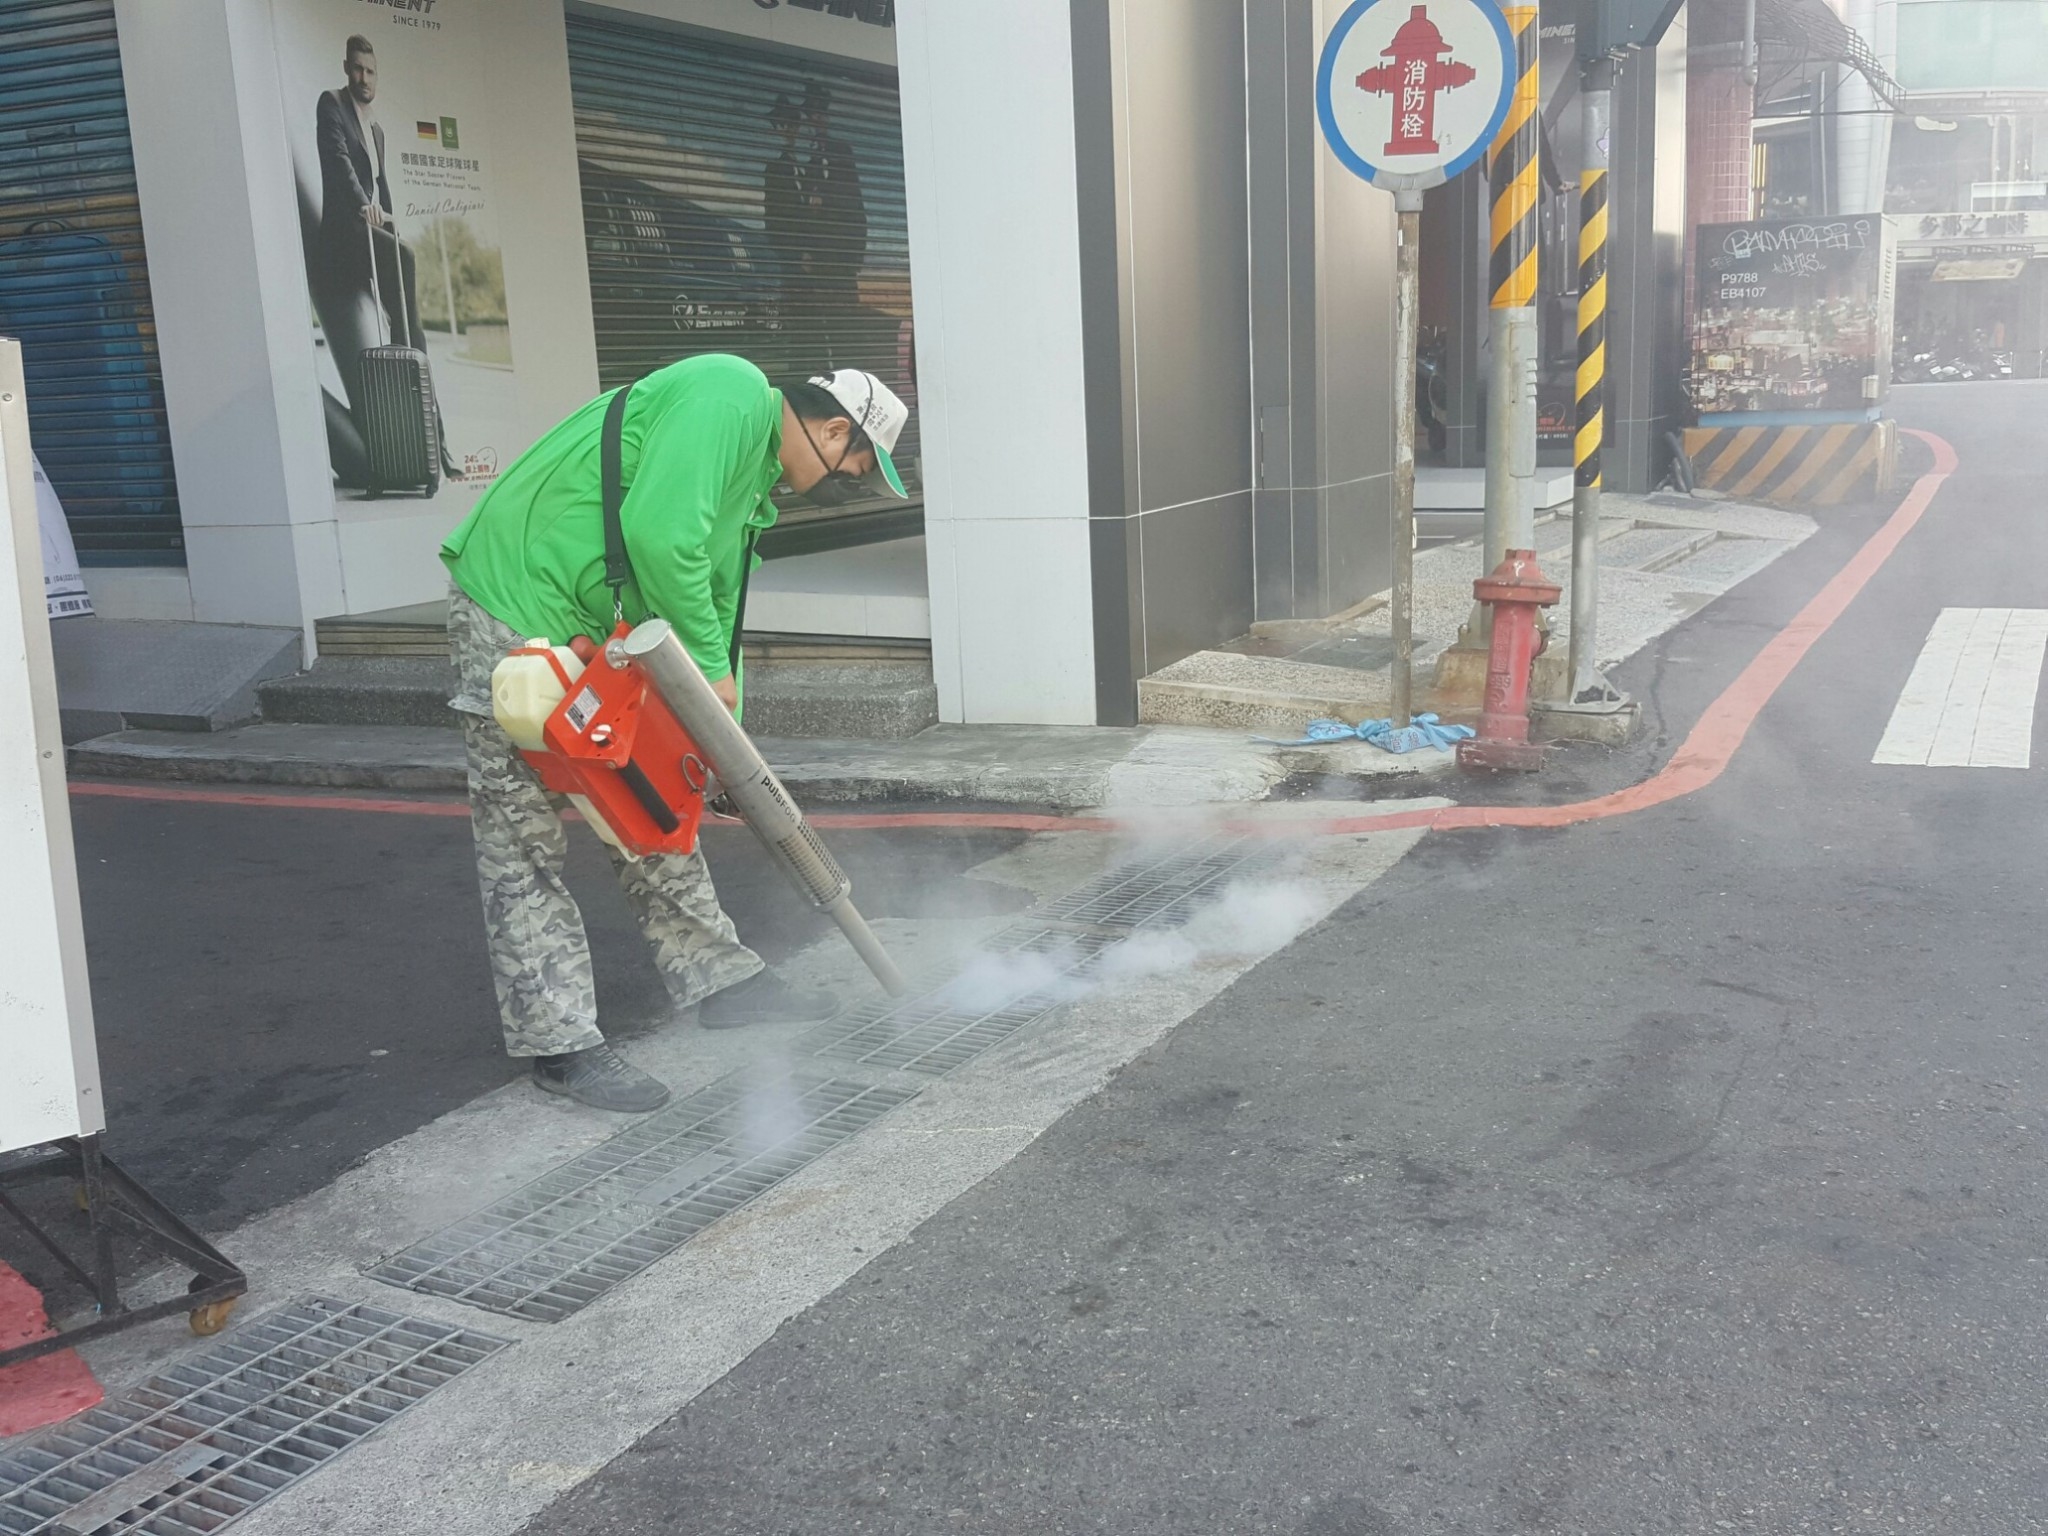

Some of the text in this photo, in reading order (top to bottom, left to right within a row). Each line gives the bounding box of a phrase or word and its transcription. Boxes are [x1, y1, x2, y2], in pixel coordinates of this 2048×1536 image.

[393, 15, 441, 31] SINCE 1979
[1401, 59, 1428, 138] 消防栓
[1721, 273, 1759, 284] P9788
[1721, 287, 1766, 299] EB4107
